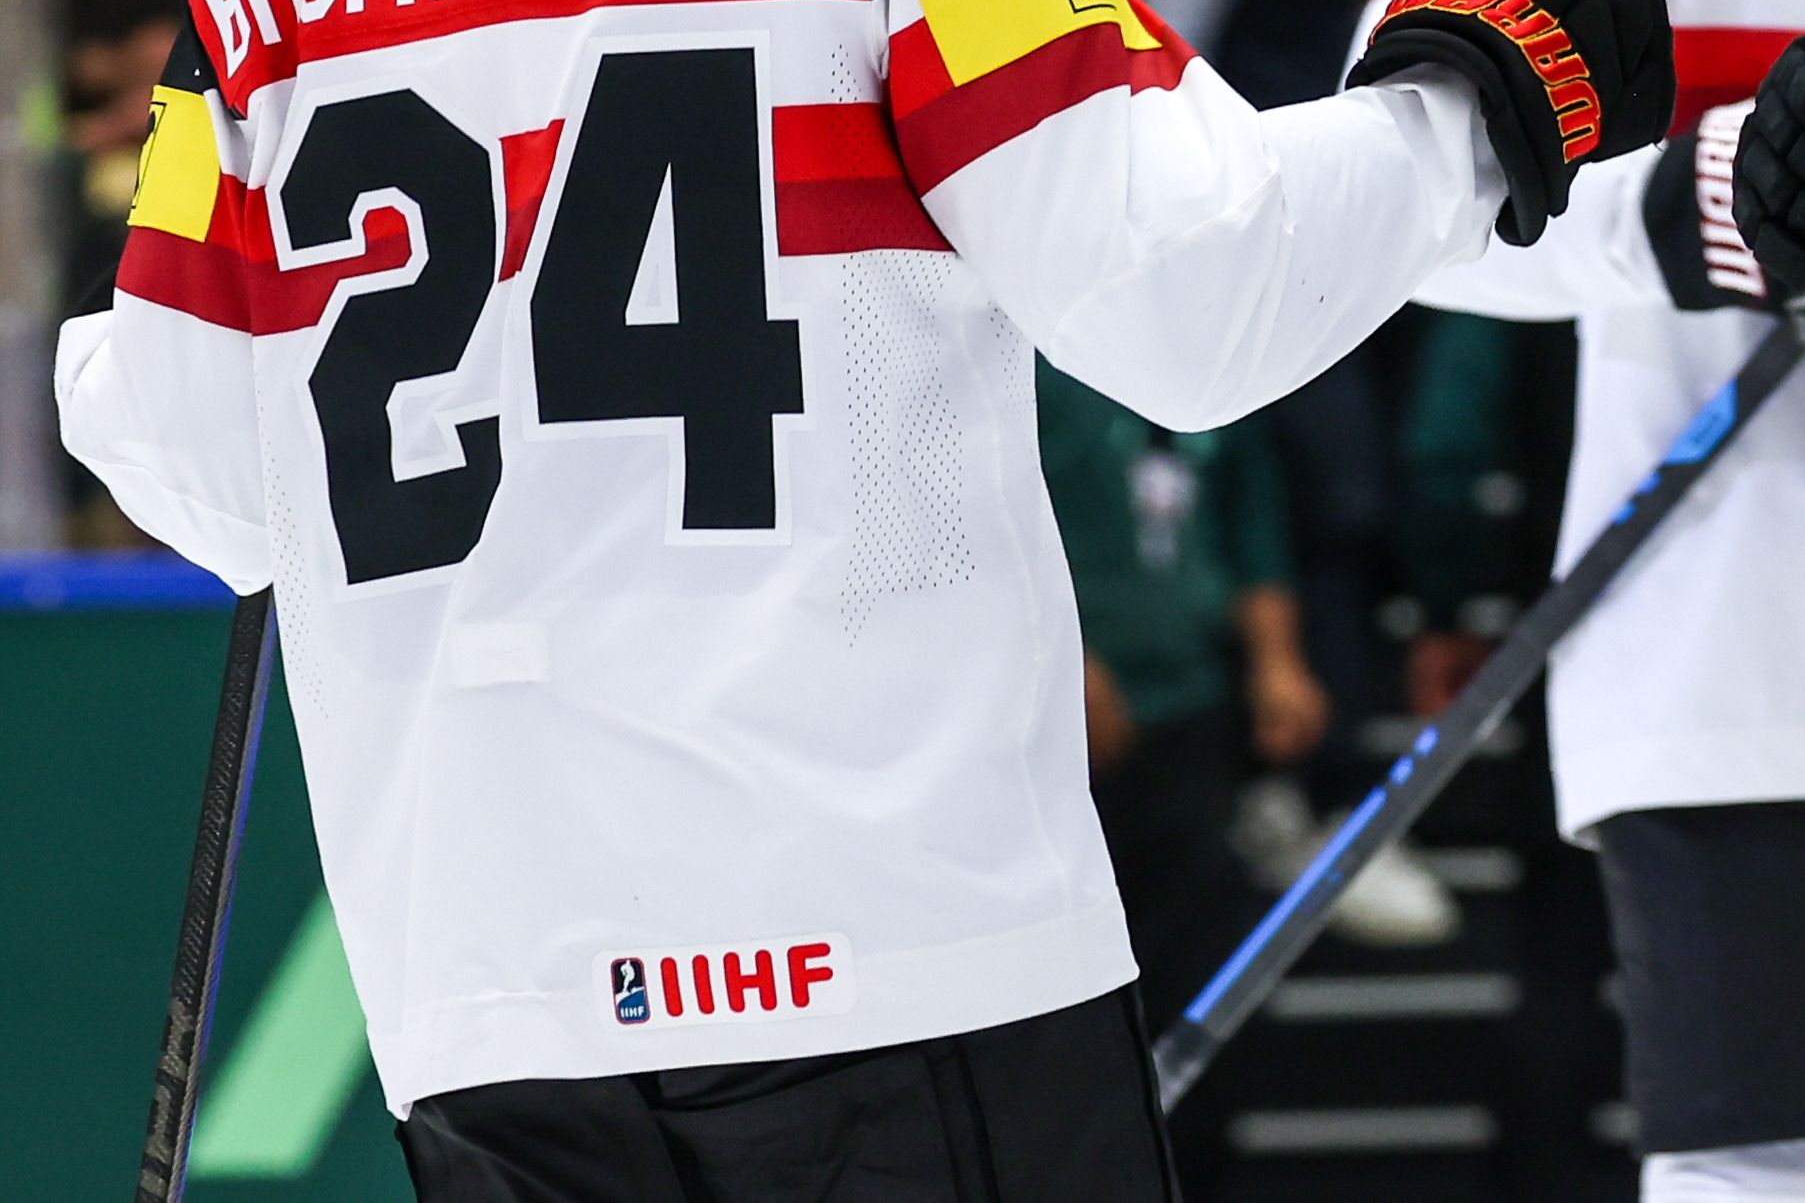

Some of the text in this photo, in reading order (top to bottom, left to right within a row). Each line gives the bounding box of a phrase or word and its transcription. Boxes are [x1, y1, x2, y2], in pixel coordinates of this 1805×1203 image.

[279, 46, 805, 584] 24
[619, 1004, 646, 1019] IIHF
[660, 942, 833, 1017] IIHF
